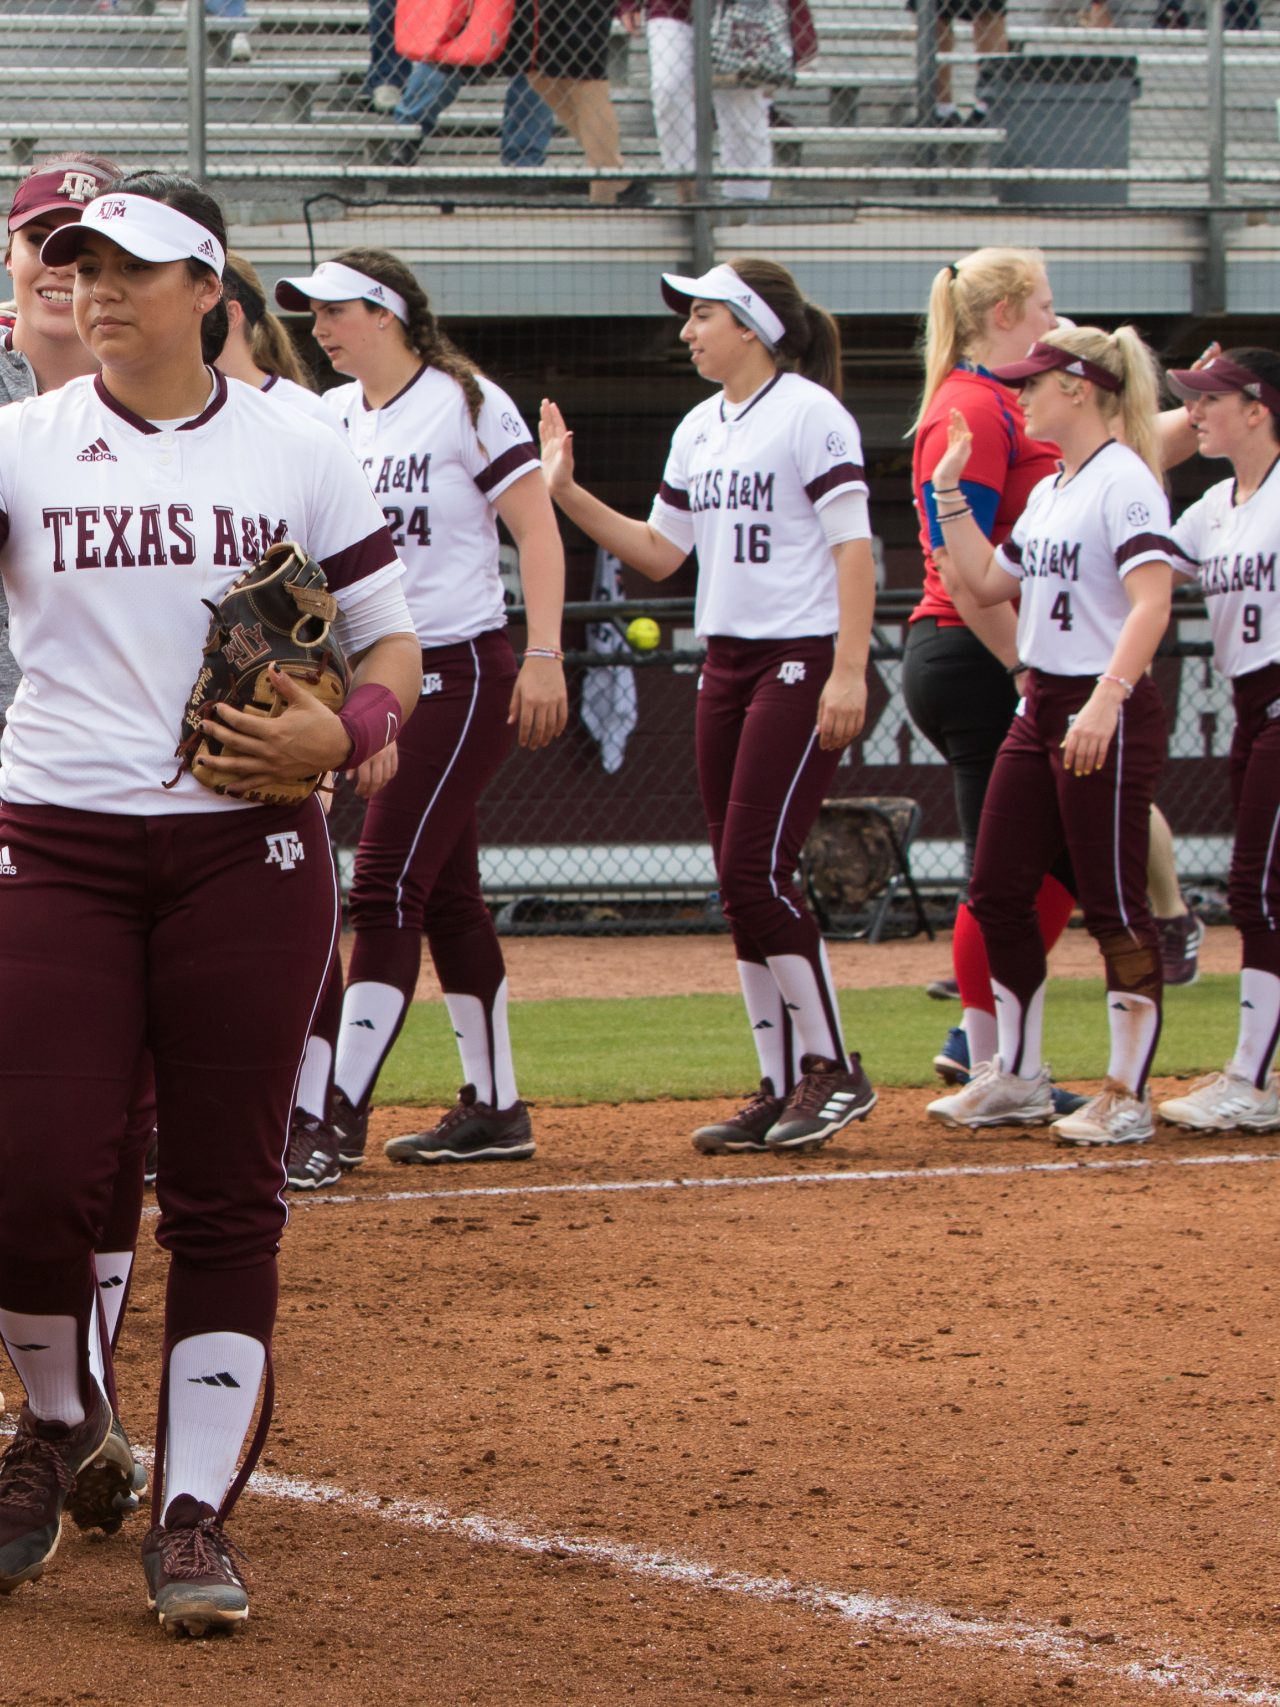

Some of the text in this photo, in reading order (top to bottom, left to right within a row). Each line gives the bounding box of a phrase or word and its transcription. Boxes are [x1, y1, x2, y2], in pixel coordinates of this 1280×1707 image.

[76, 450, 118, 463] adidas
[375, 452, 432, 494] A&M
[726, 470, 775, 512] A&M
[42, 503, 196, 573] TEXAS
[382, 505, 432, 547] 24
[733, 523, 772, 564] 16
[1038, 537, 1082, 581] A&M
[1230, 552, 1278, 592] A&M
[1050, 590, 1073, 631] 4
[1242, 603, 1262, 643] 9
